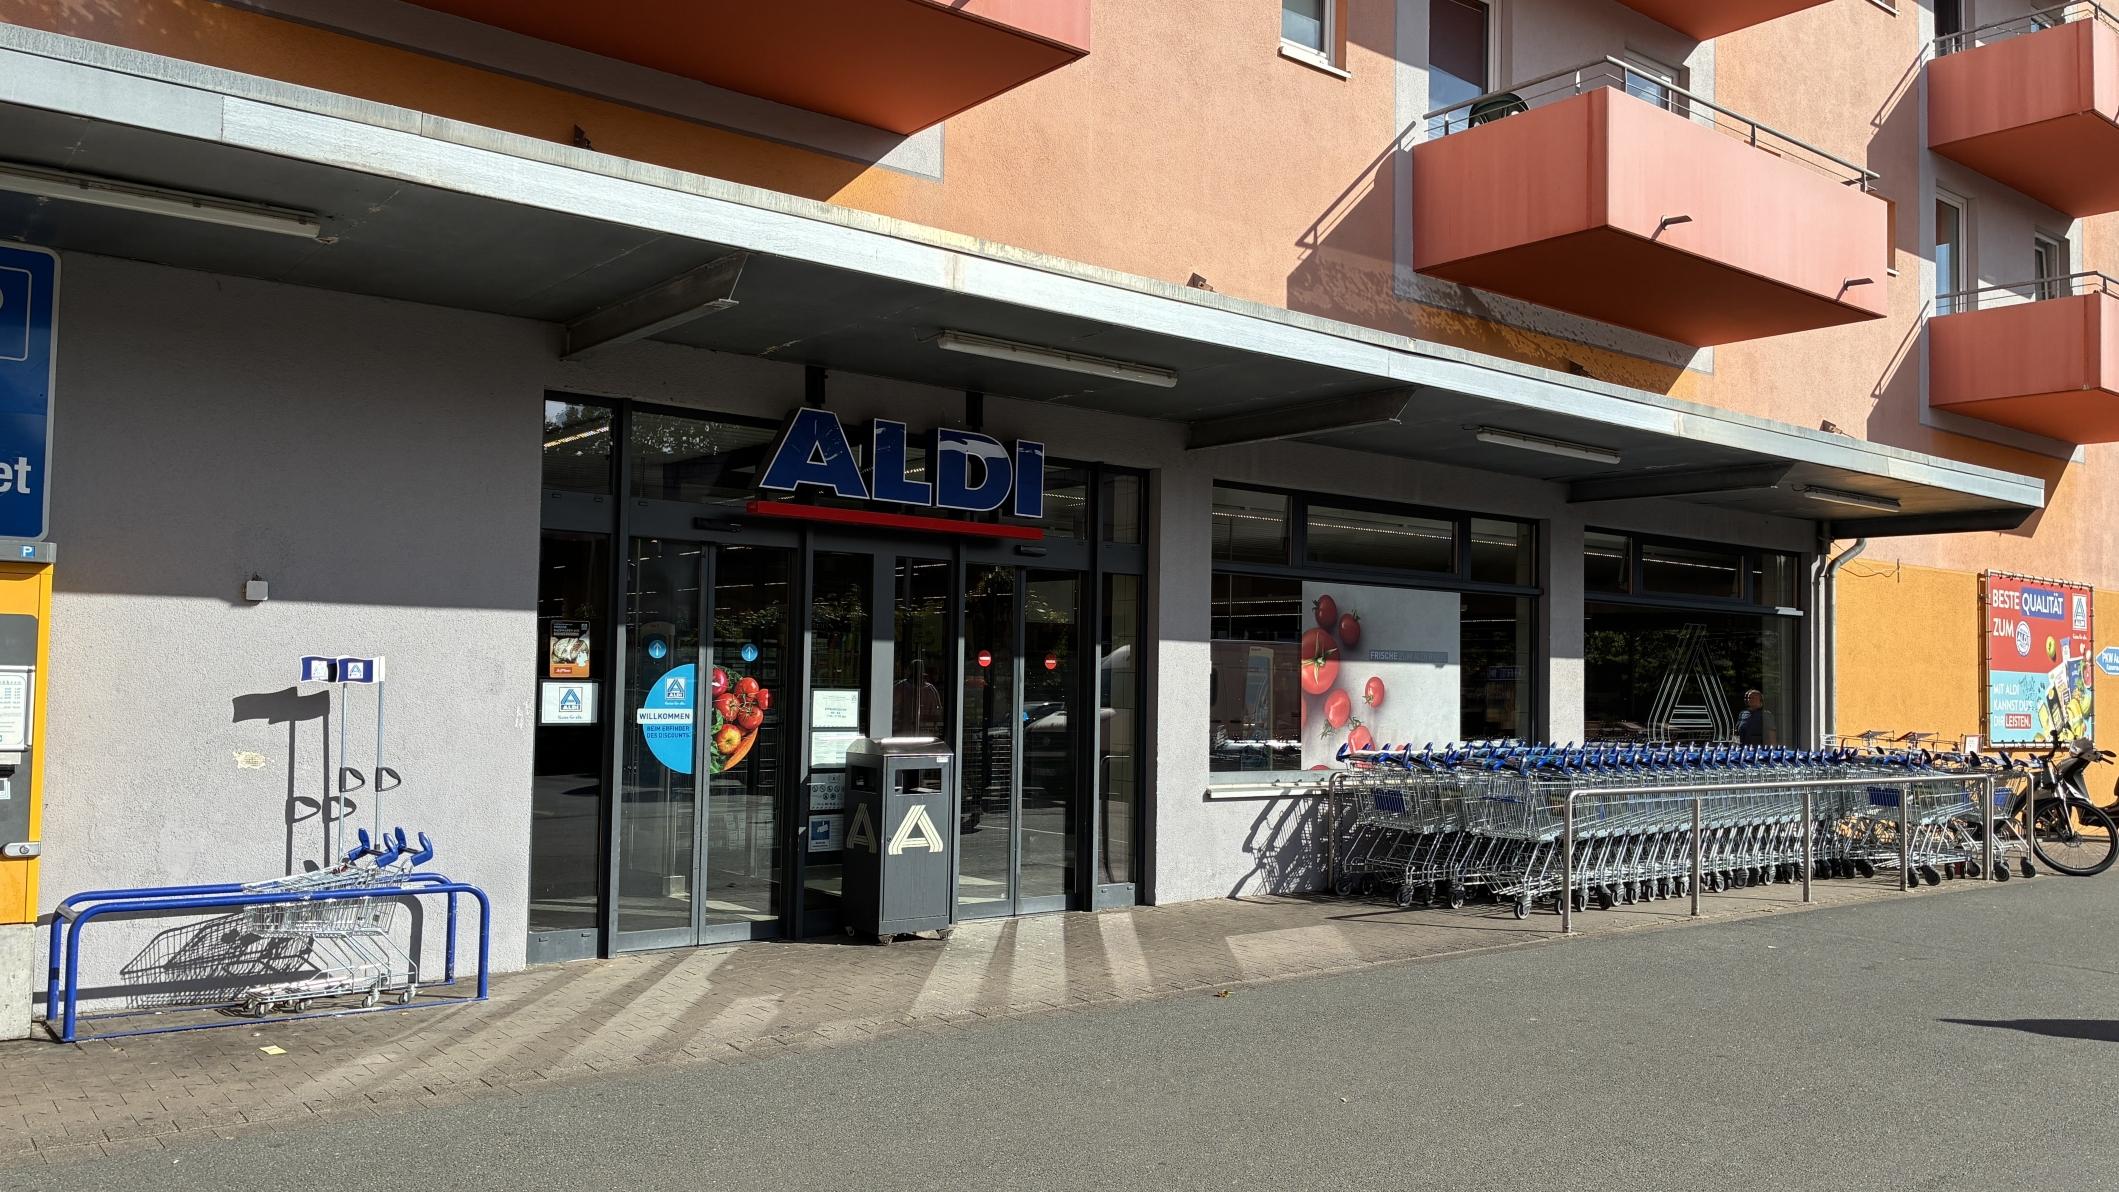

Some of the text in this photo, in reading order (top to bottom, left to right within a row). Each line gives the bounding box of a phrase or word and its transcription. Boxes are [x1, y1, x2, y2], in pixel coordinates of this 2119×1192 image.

[759, 407, 1044, 518] ALDI
[22, 546, 33, 557] P
[1993, 589, 2064, 616] BESTE QUALITÄT
[1993, 618, 2014, 638] ZUM
[1370, 651, 1398, 660] FRISCHE
[2005, 682, 2020, 696] ALDI
[1994, 699, 2018, 711] KANNST
[639, 712, 690, 720] WILLKOMMEN
[2006, 715, 2031, 728] LEISTEN.
